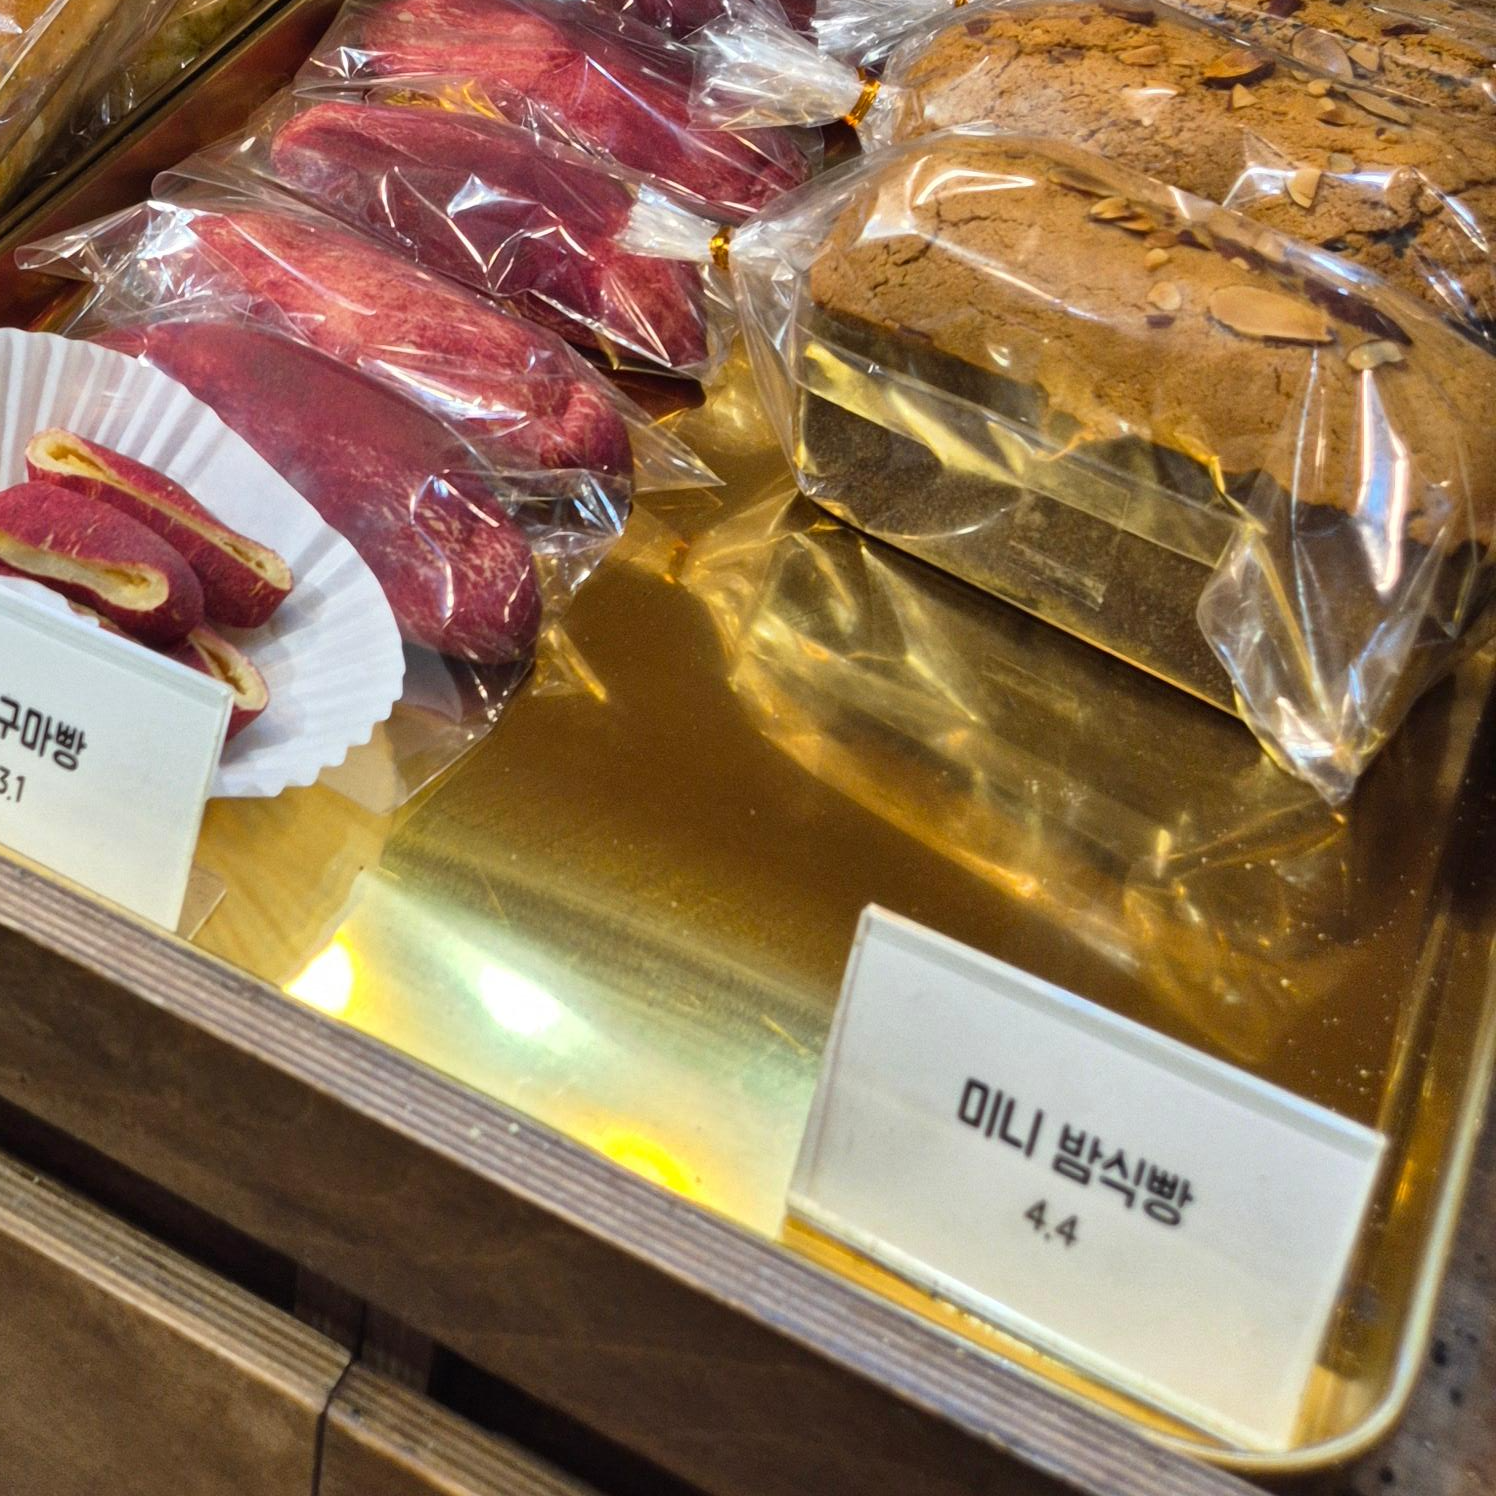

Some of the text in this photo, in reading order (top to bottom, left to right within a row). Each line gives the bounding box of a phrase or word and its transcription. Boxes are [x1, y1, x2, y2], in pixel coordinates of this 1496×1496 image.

[957, 1077, 1194, 1228] 미니 밤식빵
[1023, 1199, 1079, 1248] 4.4
